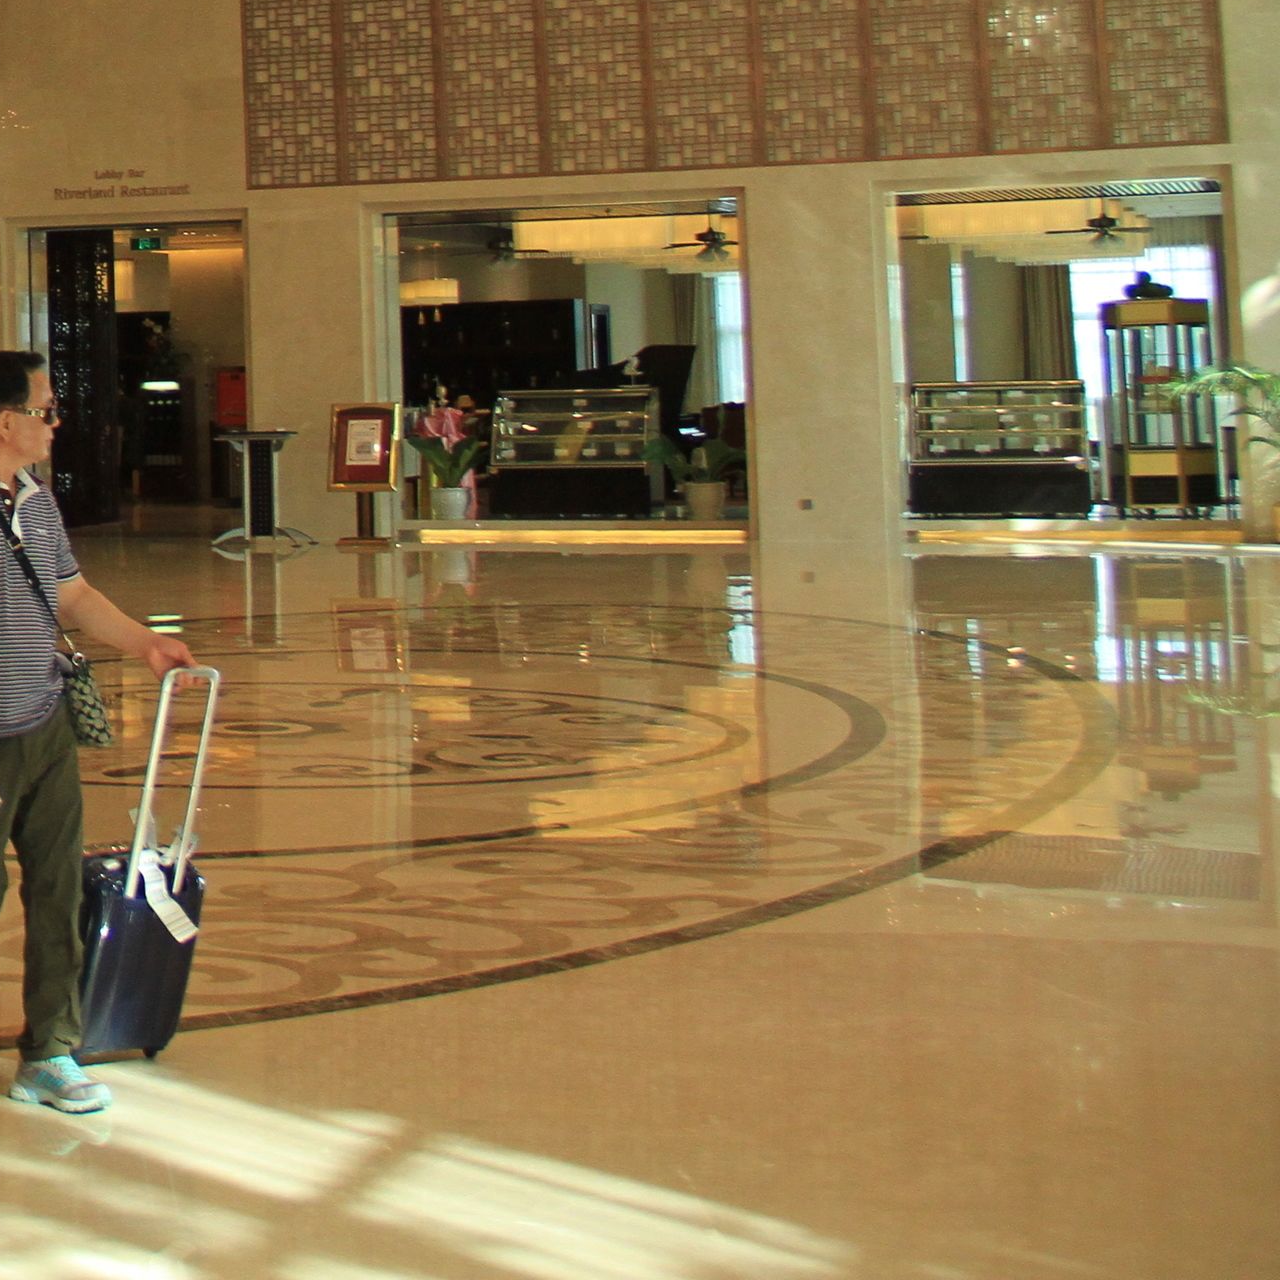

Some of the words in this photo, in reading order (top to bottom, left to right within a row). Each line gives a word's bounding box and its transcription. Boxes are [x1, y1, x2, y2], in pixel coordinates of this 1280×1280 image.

[94, 169, 123, 180] Lobby
[128, 168, 145, 178] Bar
[54, 185, 115, 200] Riverland
[120, 183, 190, 198] Restaurant
